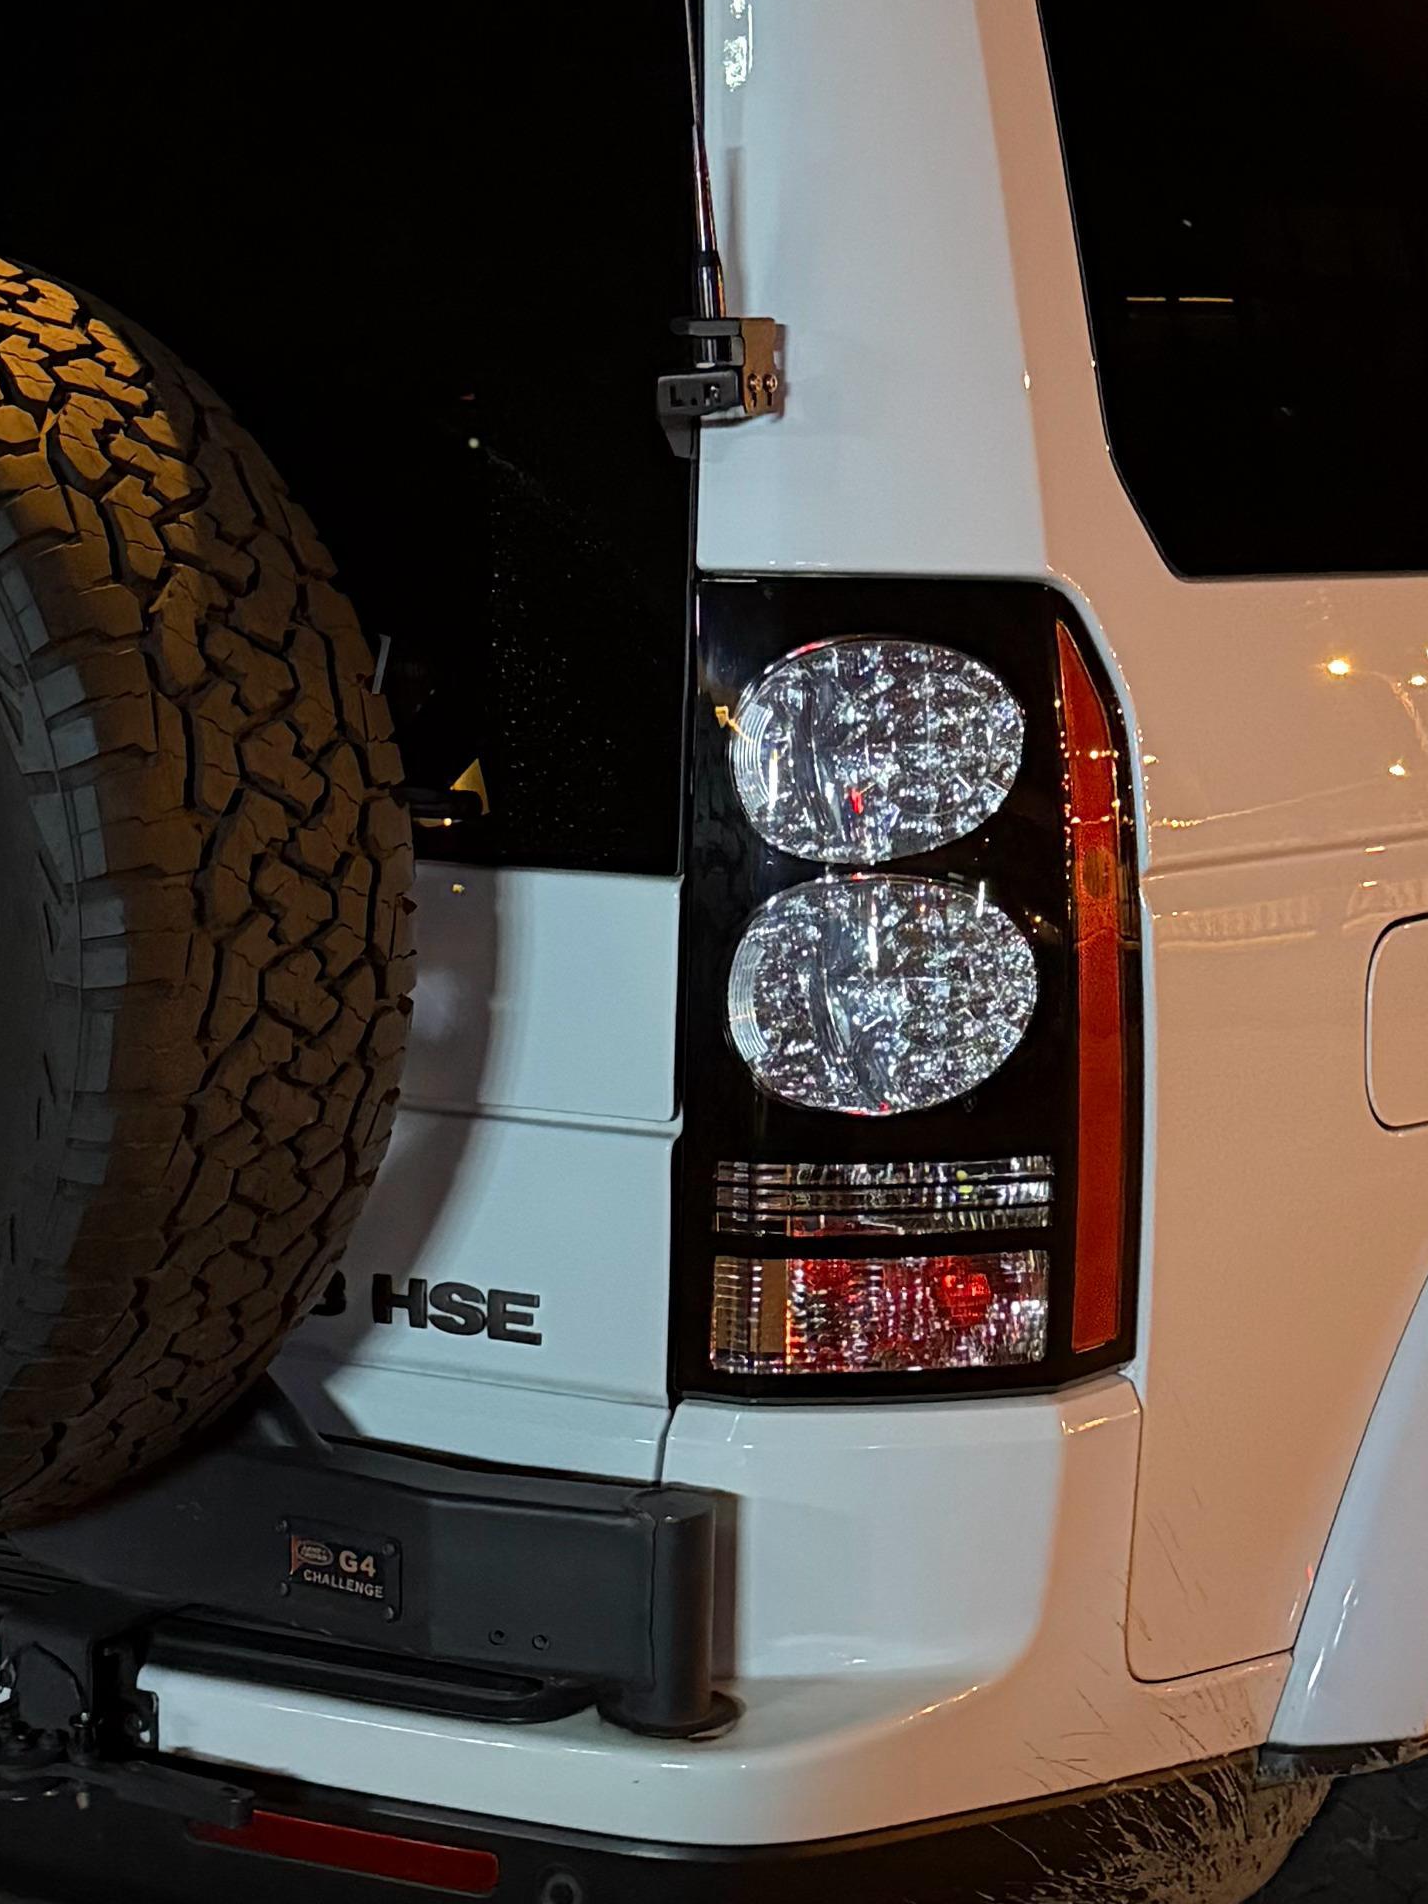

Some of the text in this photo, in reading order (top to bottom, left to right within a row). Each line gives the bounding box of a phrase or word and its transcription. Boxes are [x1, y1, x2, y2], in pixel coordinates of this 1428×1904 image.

[372, 1272, 542, 1346] HSE
[338, 1550, 376, 1578] G4
[303, 1569, 384, 1598] CHALLENGE
